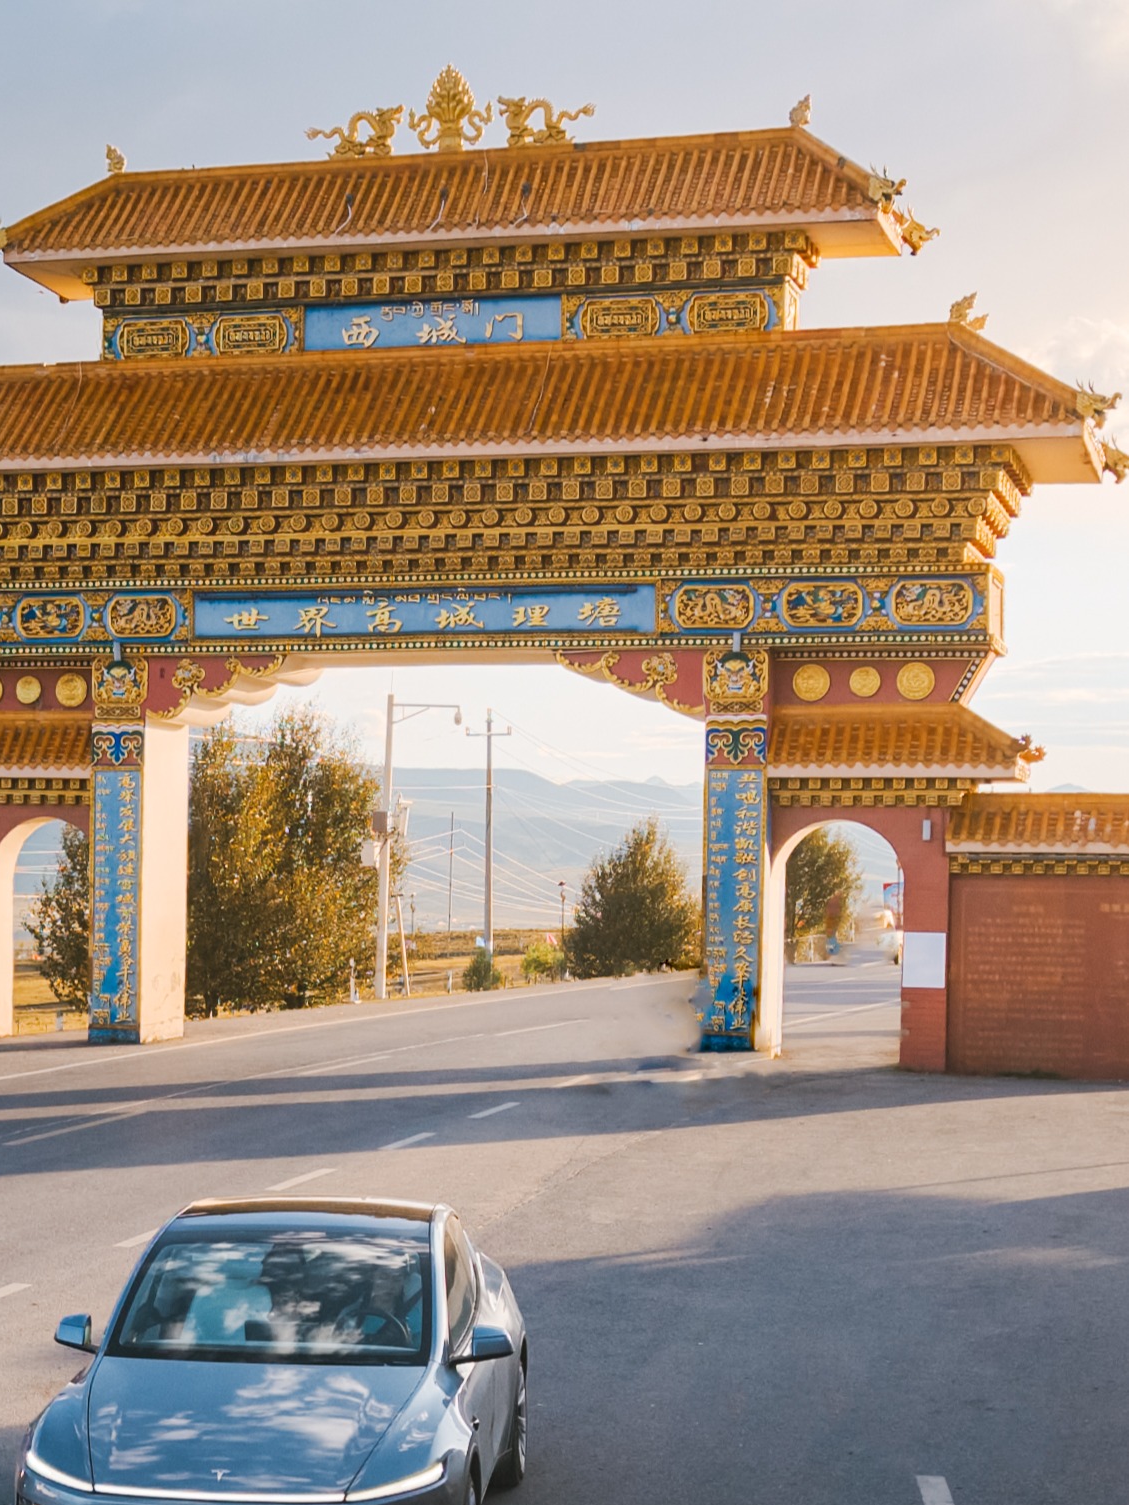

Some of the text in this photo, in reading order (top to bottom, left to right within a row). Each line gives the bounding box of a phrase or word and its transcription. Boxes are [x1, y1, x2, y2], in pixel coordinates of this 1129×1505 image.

[341, 312, 524, 348] 西城门
[222, 597, 622, 639] 世界高城理塘
